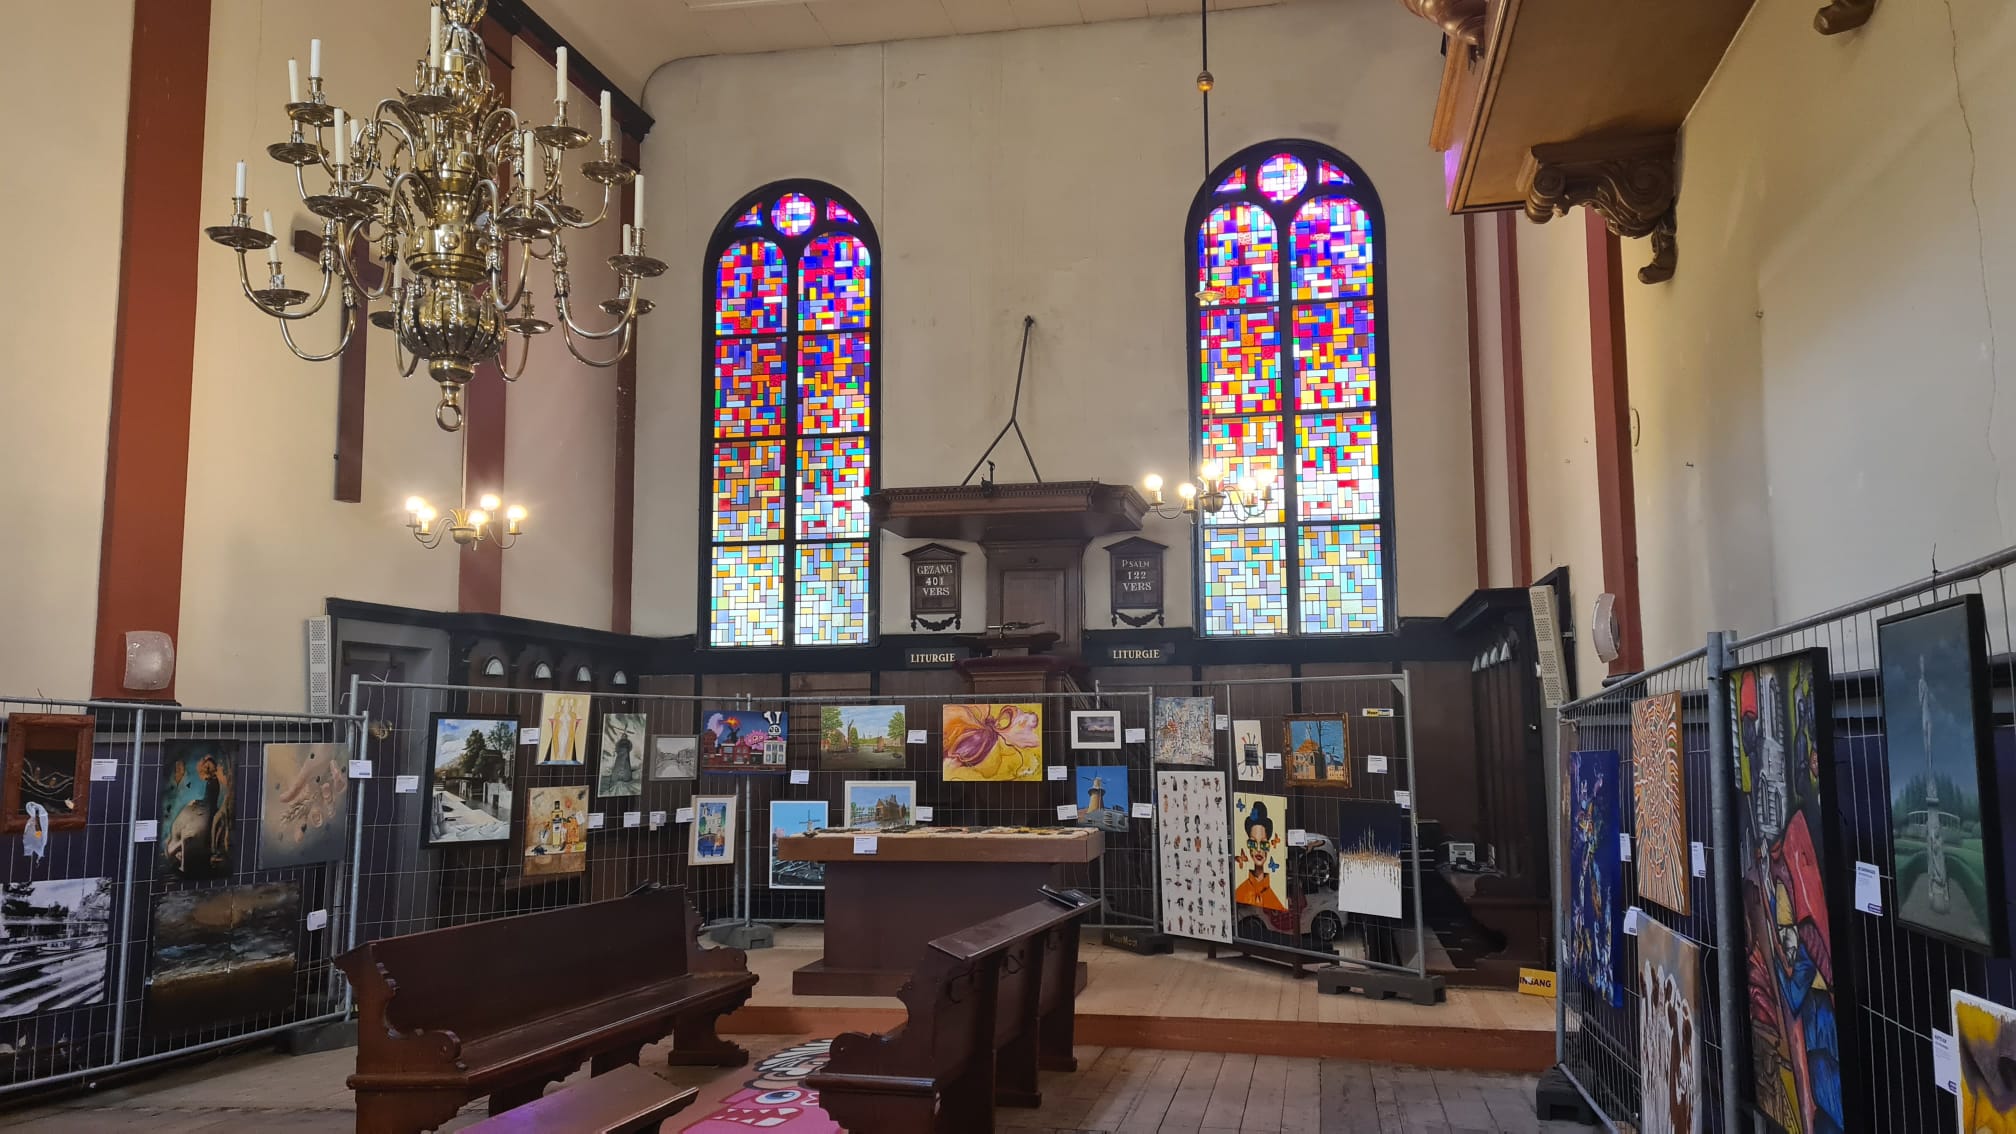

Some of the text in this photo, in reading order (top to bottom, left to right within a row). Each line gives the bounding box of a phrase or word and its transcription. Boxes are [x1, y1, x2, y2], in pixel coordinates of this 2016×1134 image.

[917, 564, 953, 575] GEZANG
[1128, 571, 1147, 580] 122
[925, 577, 944, 586] 401
[1122, 582, 1152, 591] VERS
[922, 587, 950, 596] VERS
[910, 653, 956, 663] LITURGIE
[1113, 649, 1160, 659] LITURGIE
